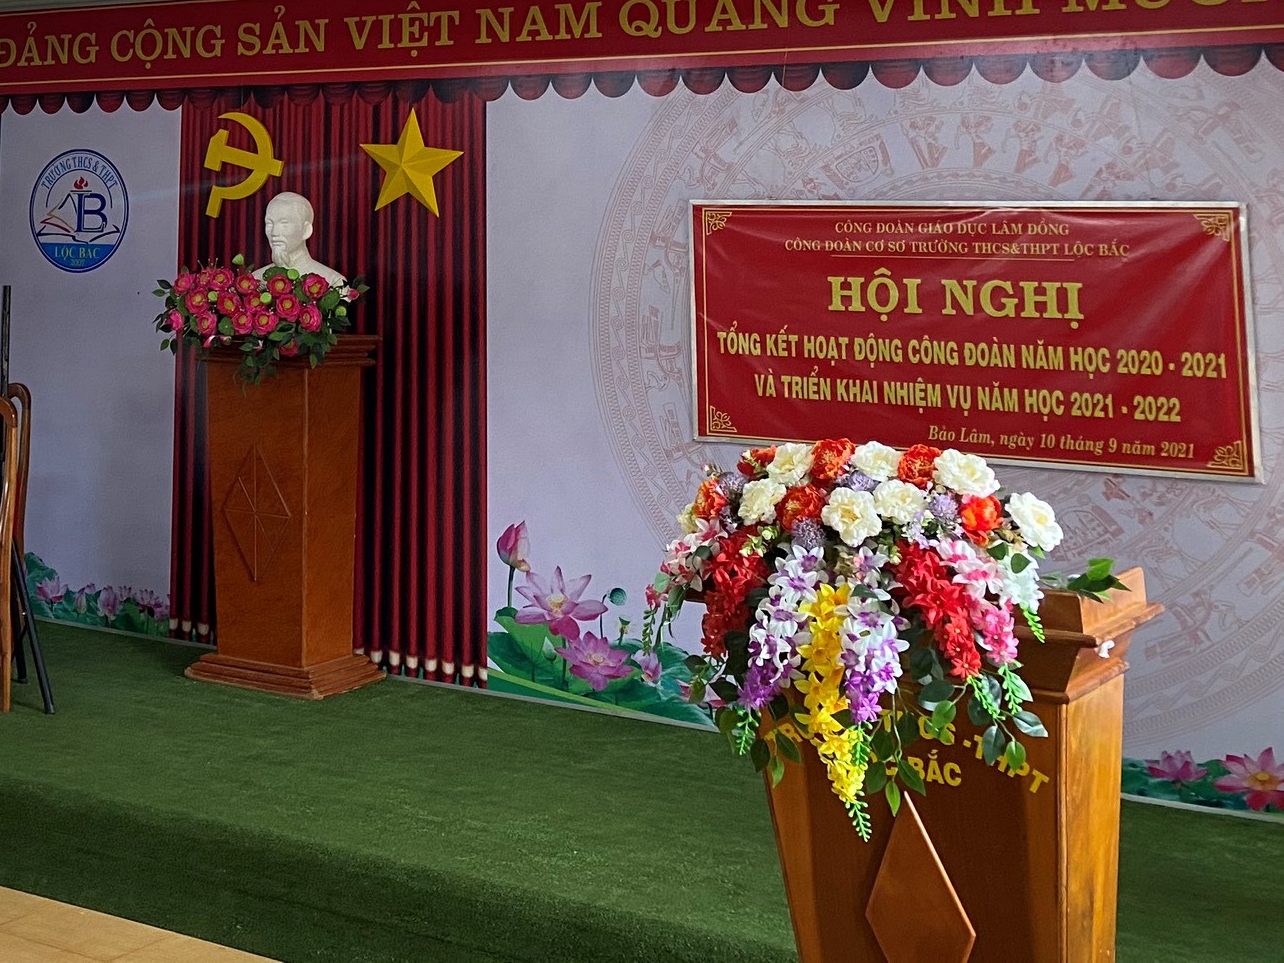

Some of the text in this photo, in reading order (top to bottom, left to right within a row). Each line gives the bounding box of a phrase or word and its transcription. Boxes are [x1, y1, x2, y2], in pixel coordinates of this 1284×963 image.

[111, 17, 225, 70] CỘNG
[237, 5, 328, 57] SẢN
[343, 0, 460, 58] VIỆT
[475, 1, 602, 45] NAM
[73, 156, 93, 170] THCS
[100, 165, 118, 190] THPT
[785, 236, 820, 251] CÔNG
[825, 236, 862, 251] ĐOÀN
[865, 240, 884, 252] CƠ
[909, 239, 968, 254] TRƯỜNG
[973, 242, 1059, 255] THCS&THPT
[1064, 241, 1094, 257] LỘC
[1099, 238, 1130, 257] BẮC
[835, 219, 1069, 237] CÔNG ĐOÀN GIÁO DỤC LÂM ĐỒNG
[828, 268, 1085, 329] HỘI NGHỊ
[717, 321, 761, 355] TỔNG
[766, 325, 798, 357] KẾT
[803, 336, 848, 365] HOẠT
[854, 333, 903, 368] ĐỘNG
[908, 335, 959, 365] CÔNG
[964, 337, 1015, 368] ĐOÀN
[1021, 340, 1064, 370] NĂM
[1070, 347, 1110, 379] HỌC
[1117, 350, 1163, 375] 2020
[1181, 352, 1227, 378] 2021
[754, 369, 776, 397] VÀ
[781, 366, 831, 401] TRIỂN
[836, 379, 878, 404] KHAI
[883, 377, 942, 413] NHIỆM
[946, 385, 971, 416] VỤ
[977, 381, 1018, 412] NĂM
[1024, 389, 1064, 421] HỌC
[1071, 392, 1113, 418] 2021
[1133, 396, 1181, 422] 2022
[928, 425, 1195, 458] Bảo Lâm, ngày 10 tháng 9 năm 2021
[907, 749, 962, 787] BẮC
